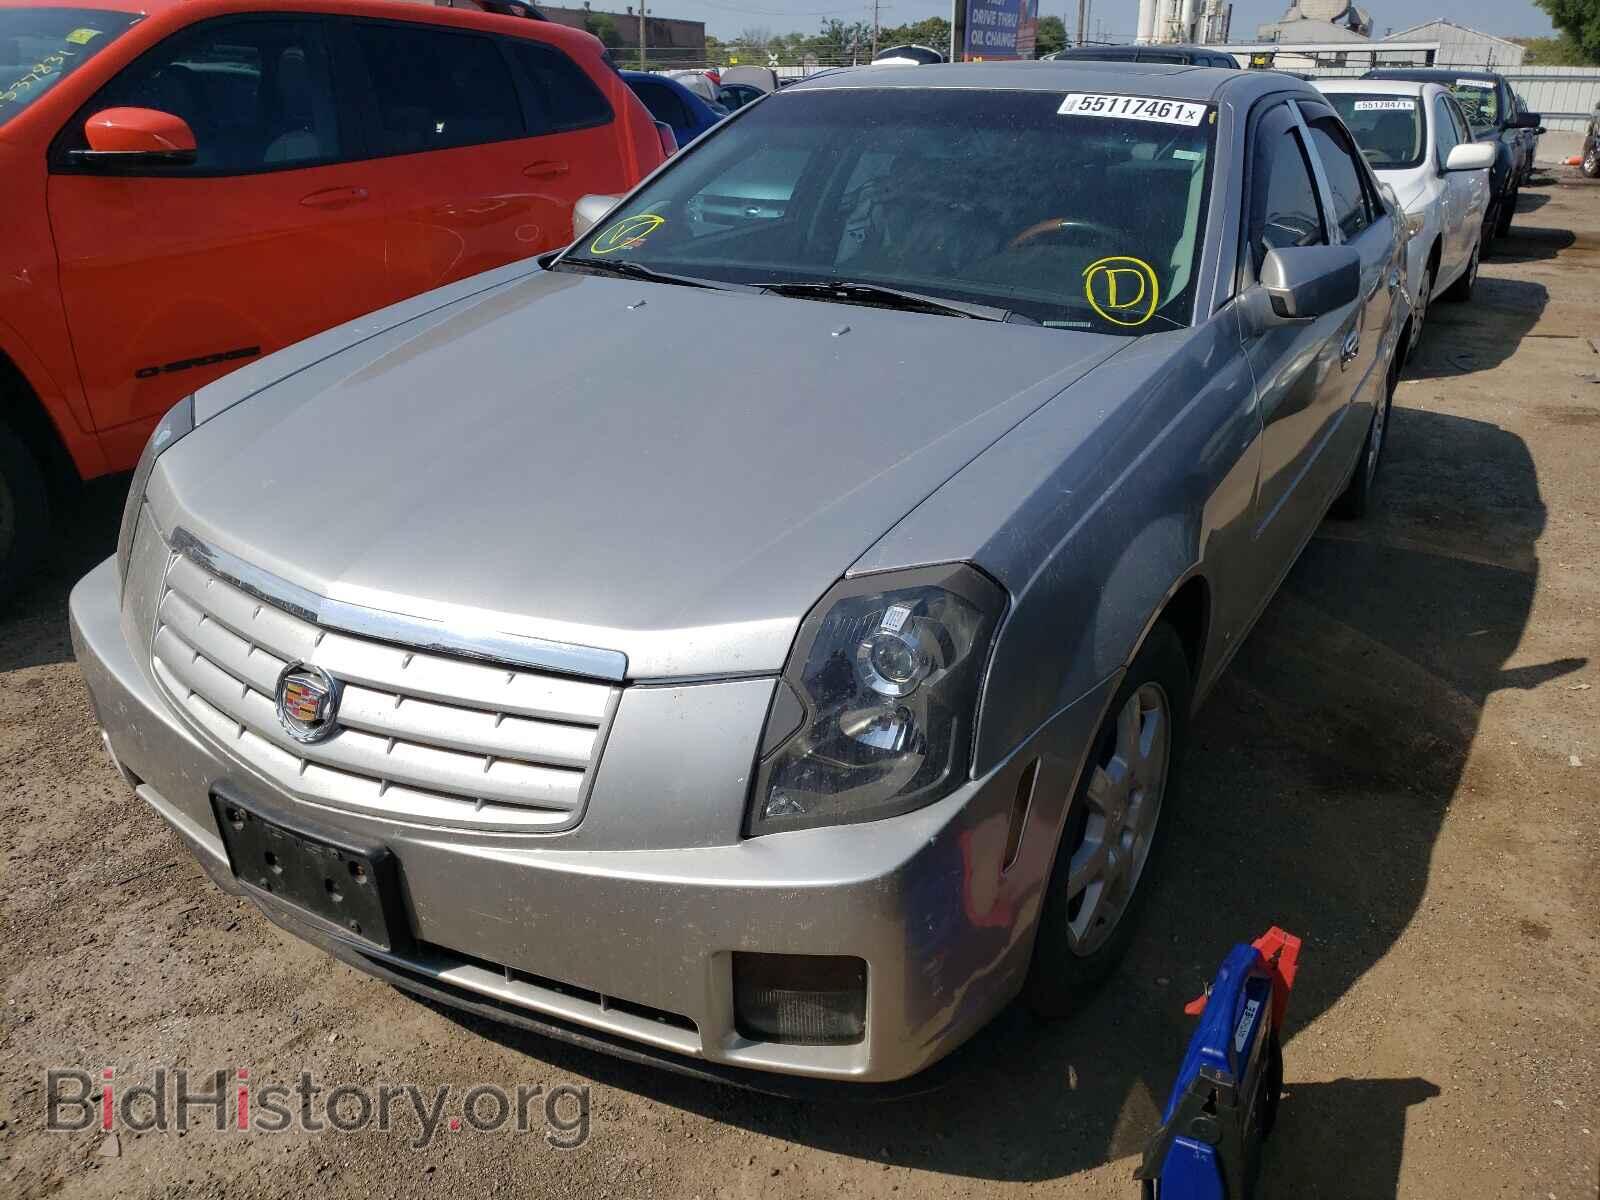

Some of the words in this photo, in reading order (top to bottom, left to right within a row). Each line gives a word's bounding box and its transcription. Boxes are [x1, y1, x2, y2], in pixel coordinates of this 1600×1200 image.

[973, 9, 997, 25] DRIVE
[998, 12, 1018, 27] THRU
[971, 30, 984, 45] OIL
[985, 31, 1017, 48] CHANGE
